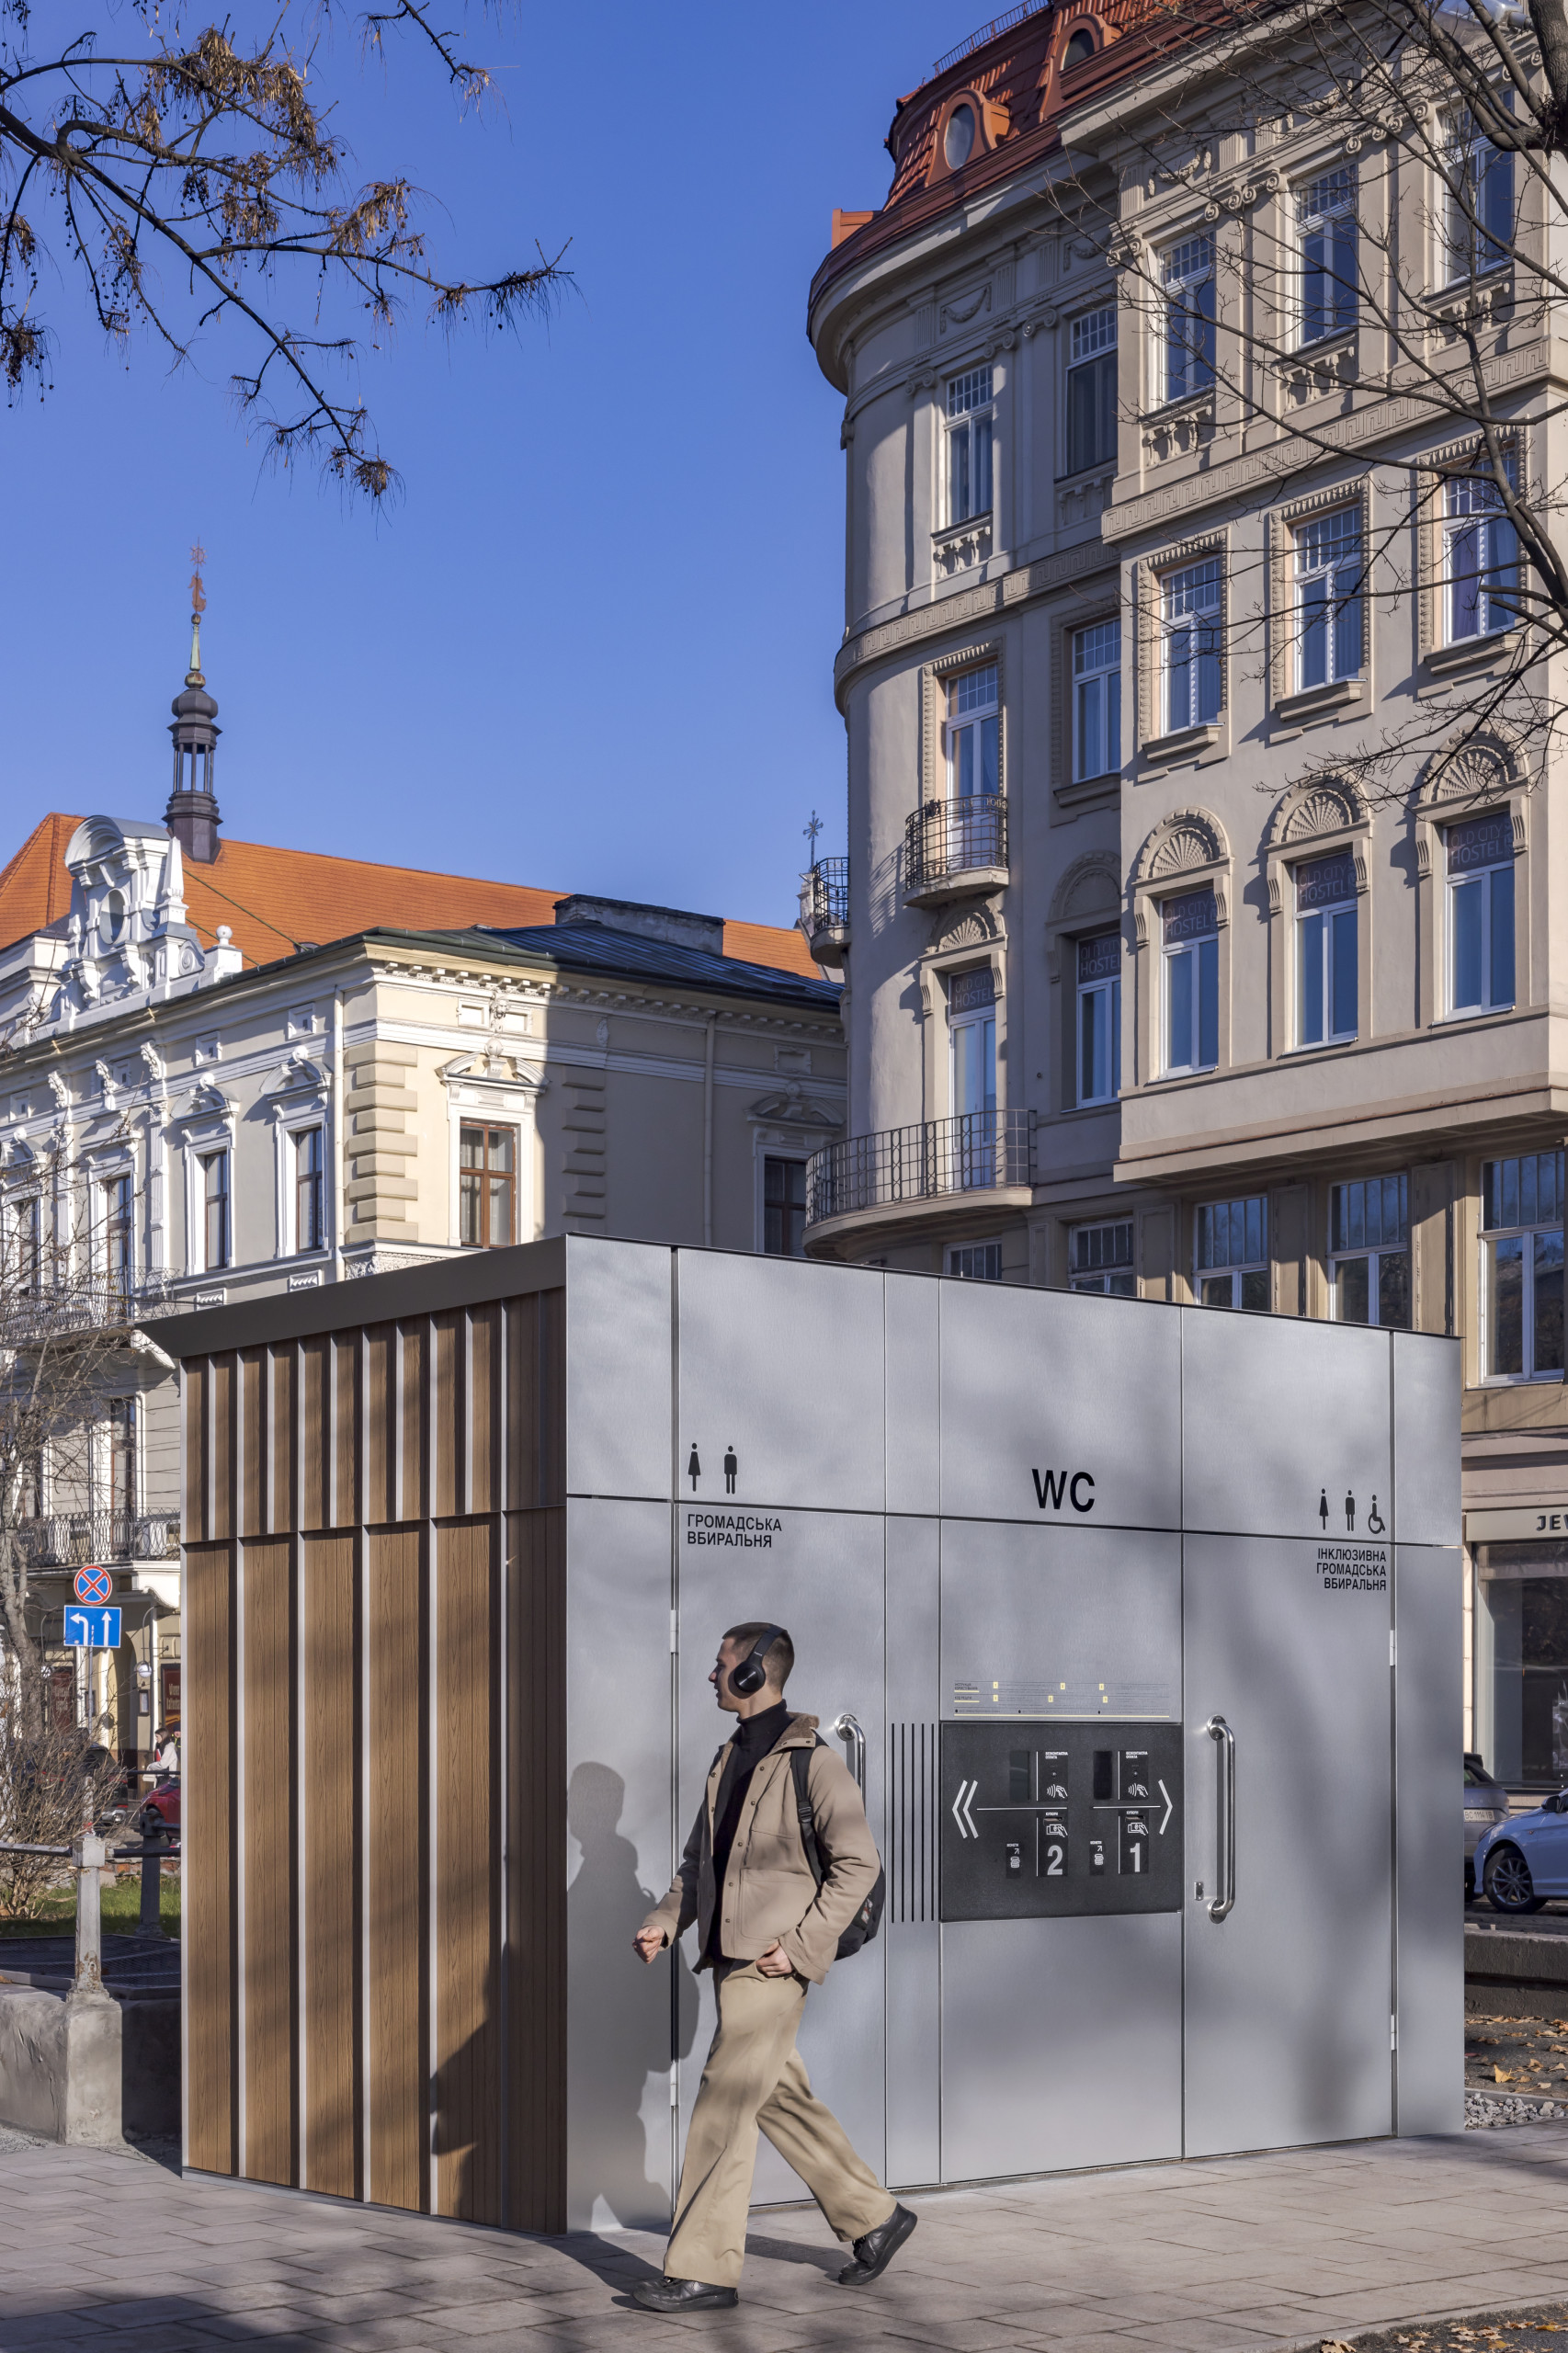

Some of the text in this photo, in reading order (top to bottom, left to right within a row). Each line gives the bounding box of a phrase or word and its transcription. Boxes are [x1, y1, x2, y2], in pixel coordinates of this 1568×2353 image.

[1451, 824, 1503, 847] OLD CITY
[1451, 839, 1504, 866] HOSTEL
[1300, 864, 1347, 887] OLD CITY
[1300, 879, 1347, 904] HOSTEL
[1165, 900, 1209, 922] OLD CITY
[1165, 915, 1210, 938] HOSTEL
[956, 978, 972, 994] OLD
[956, 986, 994, 1008] HOSTEL
[1032, 1468, 1096, 1512] WC
[687, 1513, 782, 1532] ГРОМАДСЬКА
[687, 1530, 772, 1548] ВБИРАЛЬНЯ
[1318, 1548, 1386, 1562] ІНКЛЮЗИВНА
[1316, 1563, 1386, 1577] ГРОМАДСЬКА
[1324, 1577, 1386, 1591] ВБИРАЛЬНЯ
[1047, 1845, 1063, 1876] 2
[1130, 1843, 1141, 1872] 1
